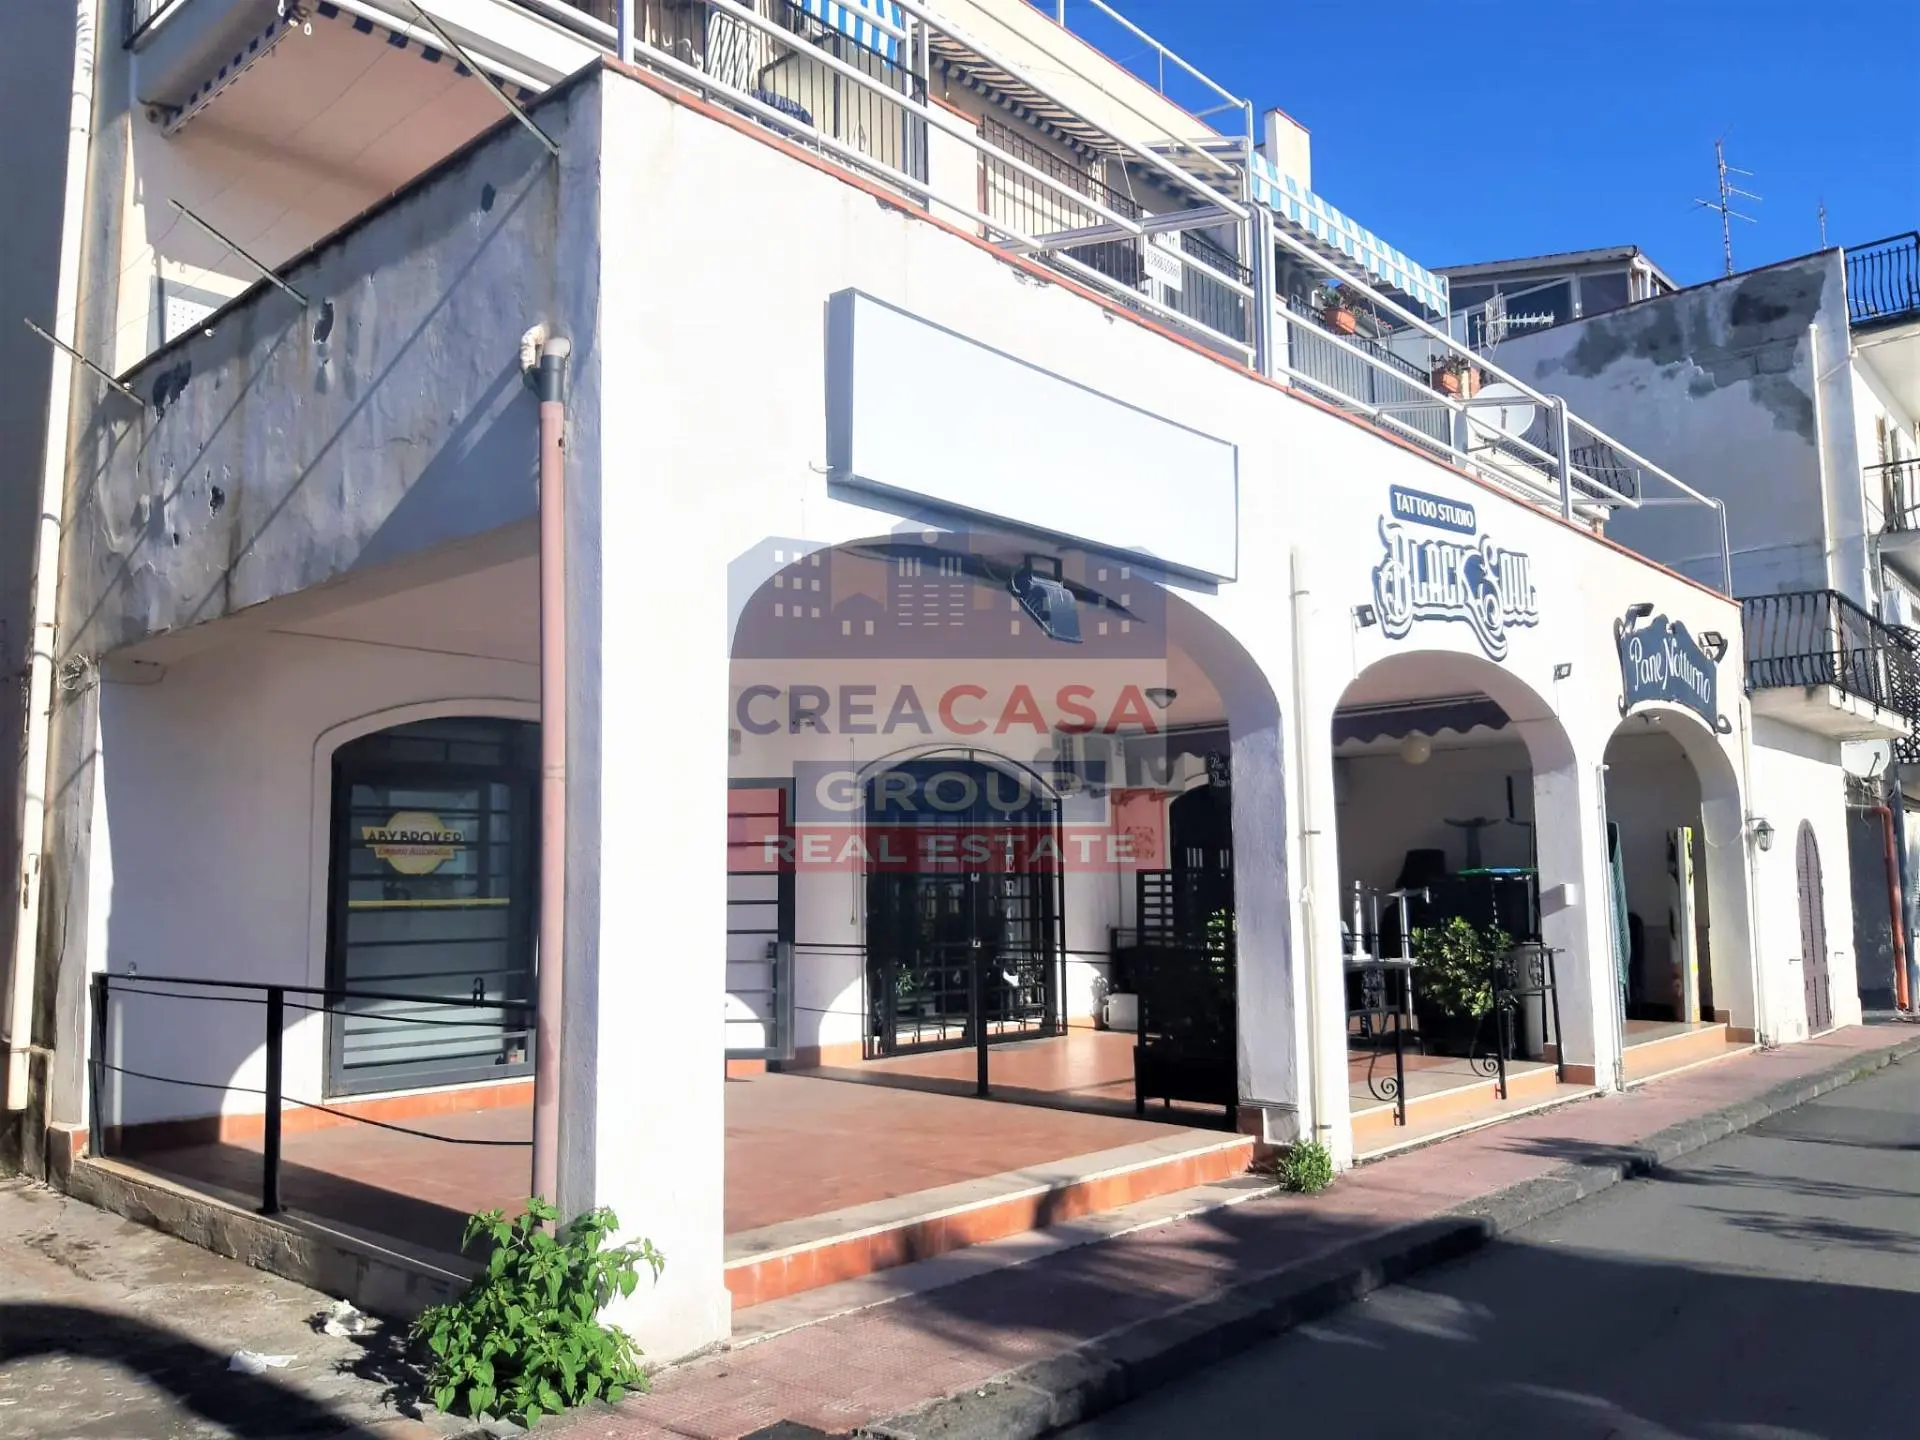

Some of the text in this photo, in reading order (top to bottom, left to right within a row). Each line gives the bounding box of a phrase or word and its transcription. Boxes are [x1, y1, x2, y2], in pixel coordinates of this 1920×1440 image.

[1394, 492, 1474, 528] TATTOO STUDIO
[1629, 637, 1711, 704] Pane Notturno
